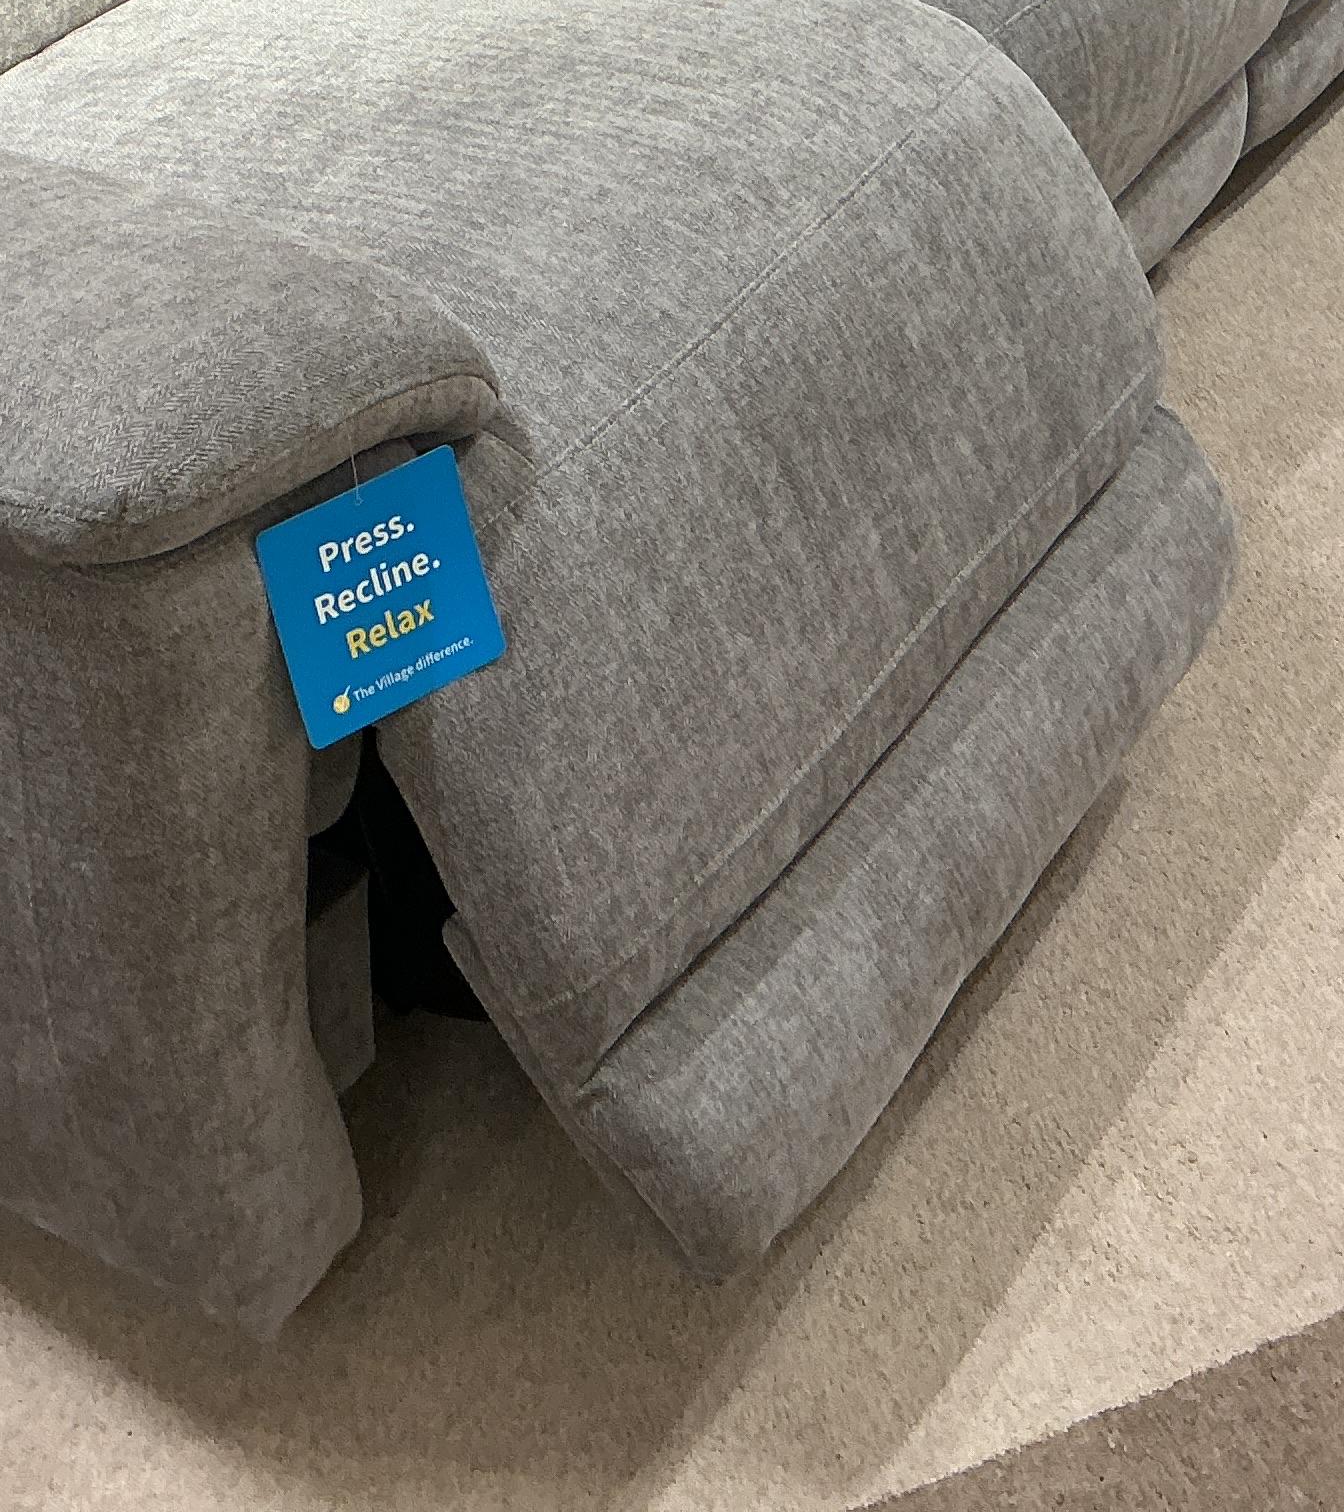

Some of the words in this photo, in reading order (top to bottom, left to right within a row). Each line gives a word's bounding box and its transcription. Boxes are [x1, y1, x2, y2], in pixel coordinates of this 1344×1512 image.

[317, 515, 415, 573] Press.
[314, 552, 442, 626] Recline.
[345, 599, 435, 660] Relax
[353, 684, 376, 703] The
[375, 663, 415, 692] Village
[415, 636, 474, 672] difference.
